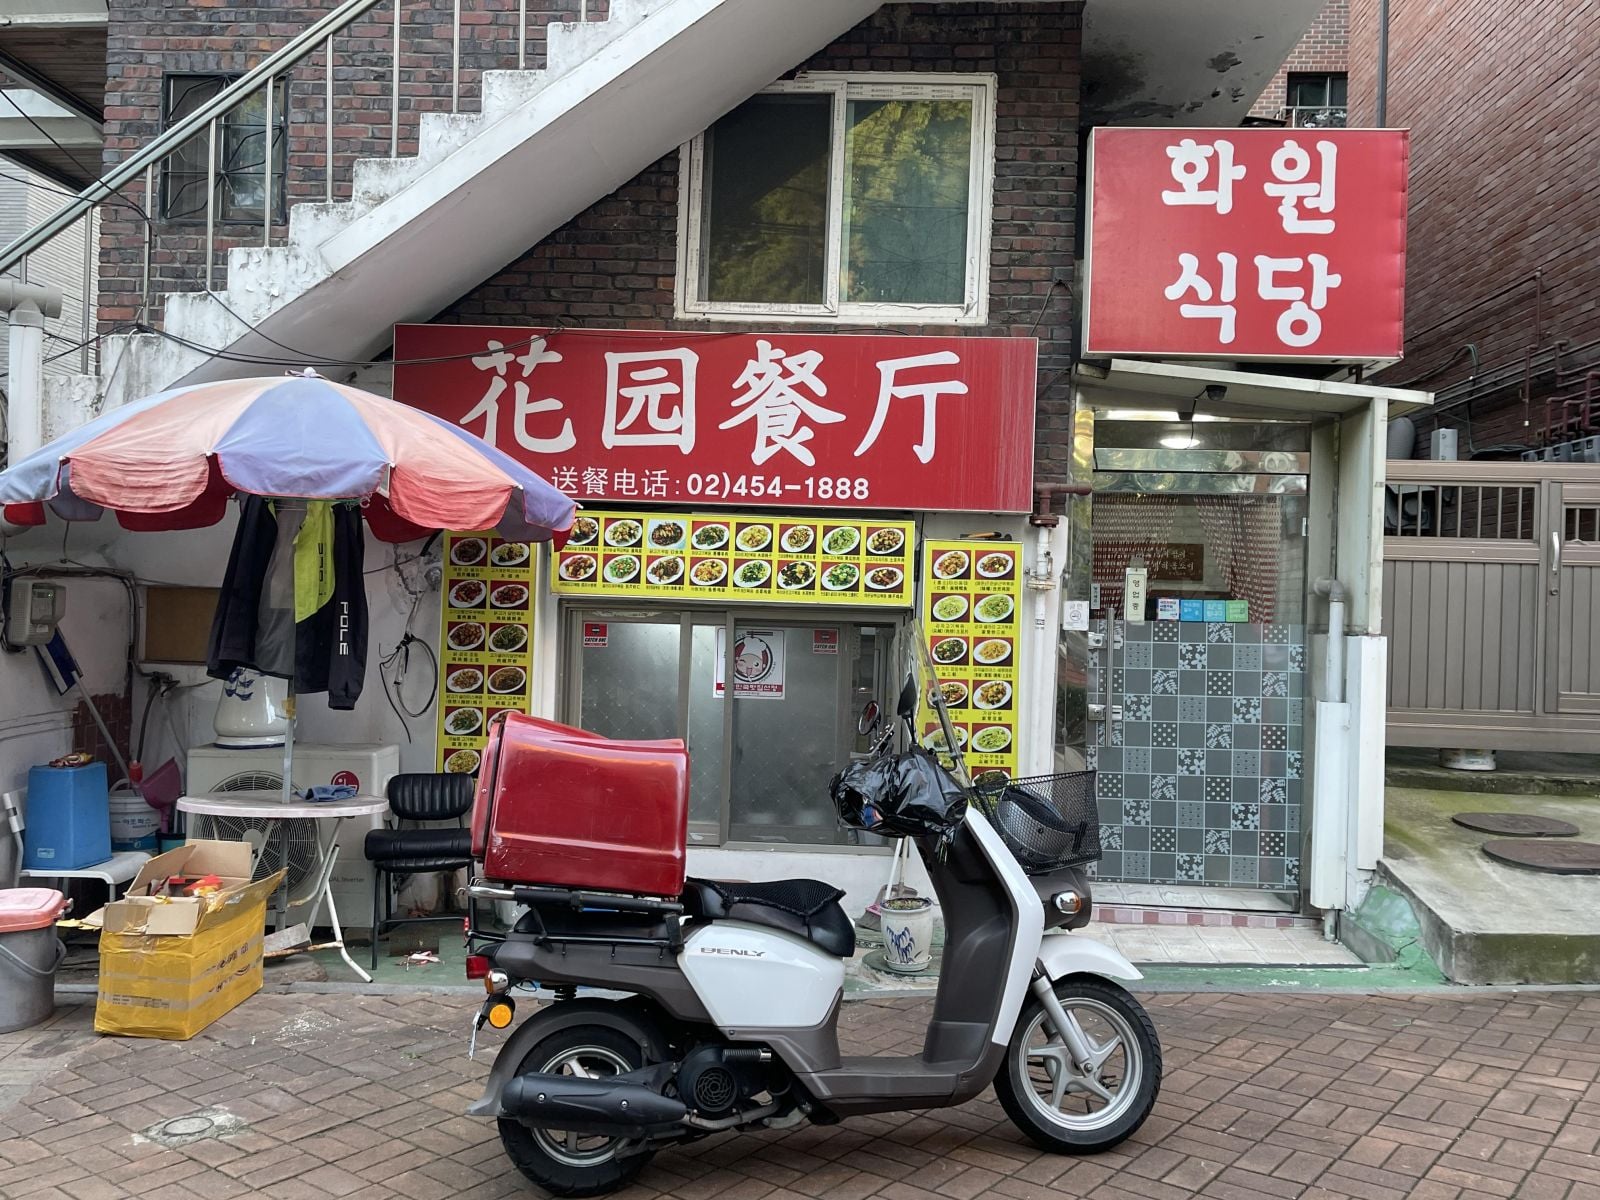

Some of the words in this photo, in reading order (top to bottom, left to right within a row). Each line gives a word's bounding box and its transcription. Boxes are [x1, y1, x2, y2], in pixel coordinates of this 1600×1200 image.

[1161, 138, 1337, 234] 화원
[1164, 252, 1341, 347] 식당
[459, 334, 969, 467] 花园餐厅
[686, 472, 870, 500] 02)454-1888
[1132, 579, 1140, 611] 영업중
[340, 602, 349, 655] POLE
[700, 947, 767, 957] BENLY
